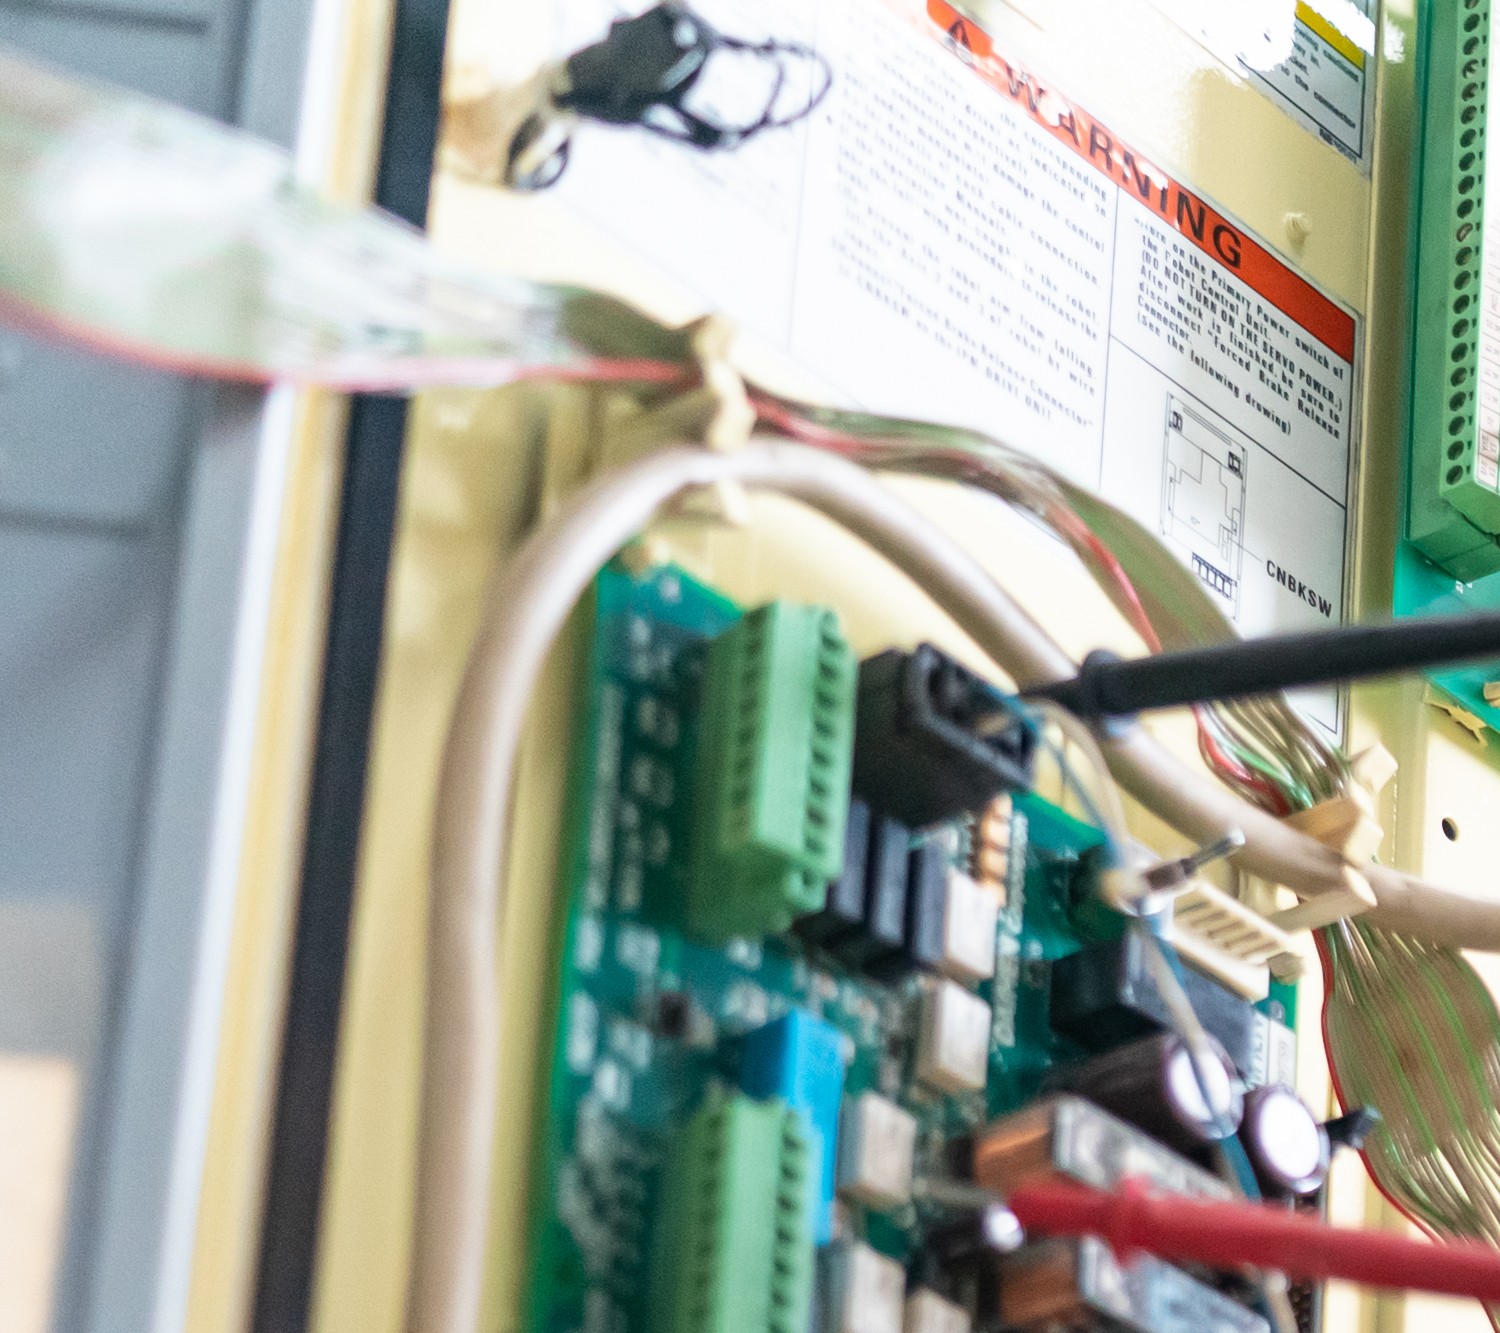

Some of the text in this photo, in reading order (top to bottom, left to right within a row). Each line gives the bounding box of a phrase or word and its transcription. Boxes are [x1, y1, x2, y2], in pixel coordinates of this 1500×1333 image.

[1004, 63, 1242, 268] WARNING
[1139, 265, 1168, 293] After
[1176, 293, 1204, 320] work
[1211, 319, 1222, 333] is
[1281, 372, 1293, 388] be
[1300, 388, 1324, 411] sure
[1329, 409, 1340, 424] to
[1164, 267, 1185, 290] NOT
[1188, 285, 1217, 314] TURN
[1220, 309, 1235, 328] ON
[1239, 324, 1259, 346] THE
[1262, 341, 1295, 373] SERVO
[1189, 255, 1206, 274] the
[1210, 271, 1251, 311] Primary
[1256, 305, 1289, 338] Power
[1294, 335, 1329, 368] switch
[1332, 364, 1343, 380] of
[1200, 279, 1239, 315] Control
[1138, 280, 1201, 334] disconnect
[1258, 370, 1289, 401] Brake
[1297, 399, 1340, 439] Release
[1166, 333, 1185, 354] the
[1189, 350, 1240, 398] following
[1266, 560, 1332, 618] CNBKSW
